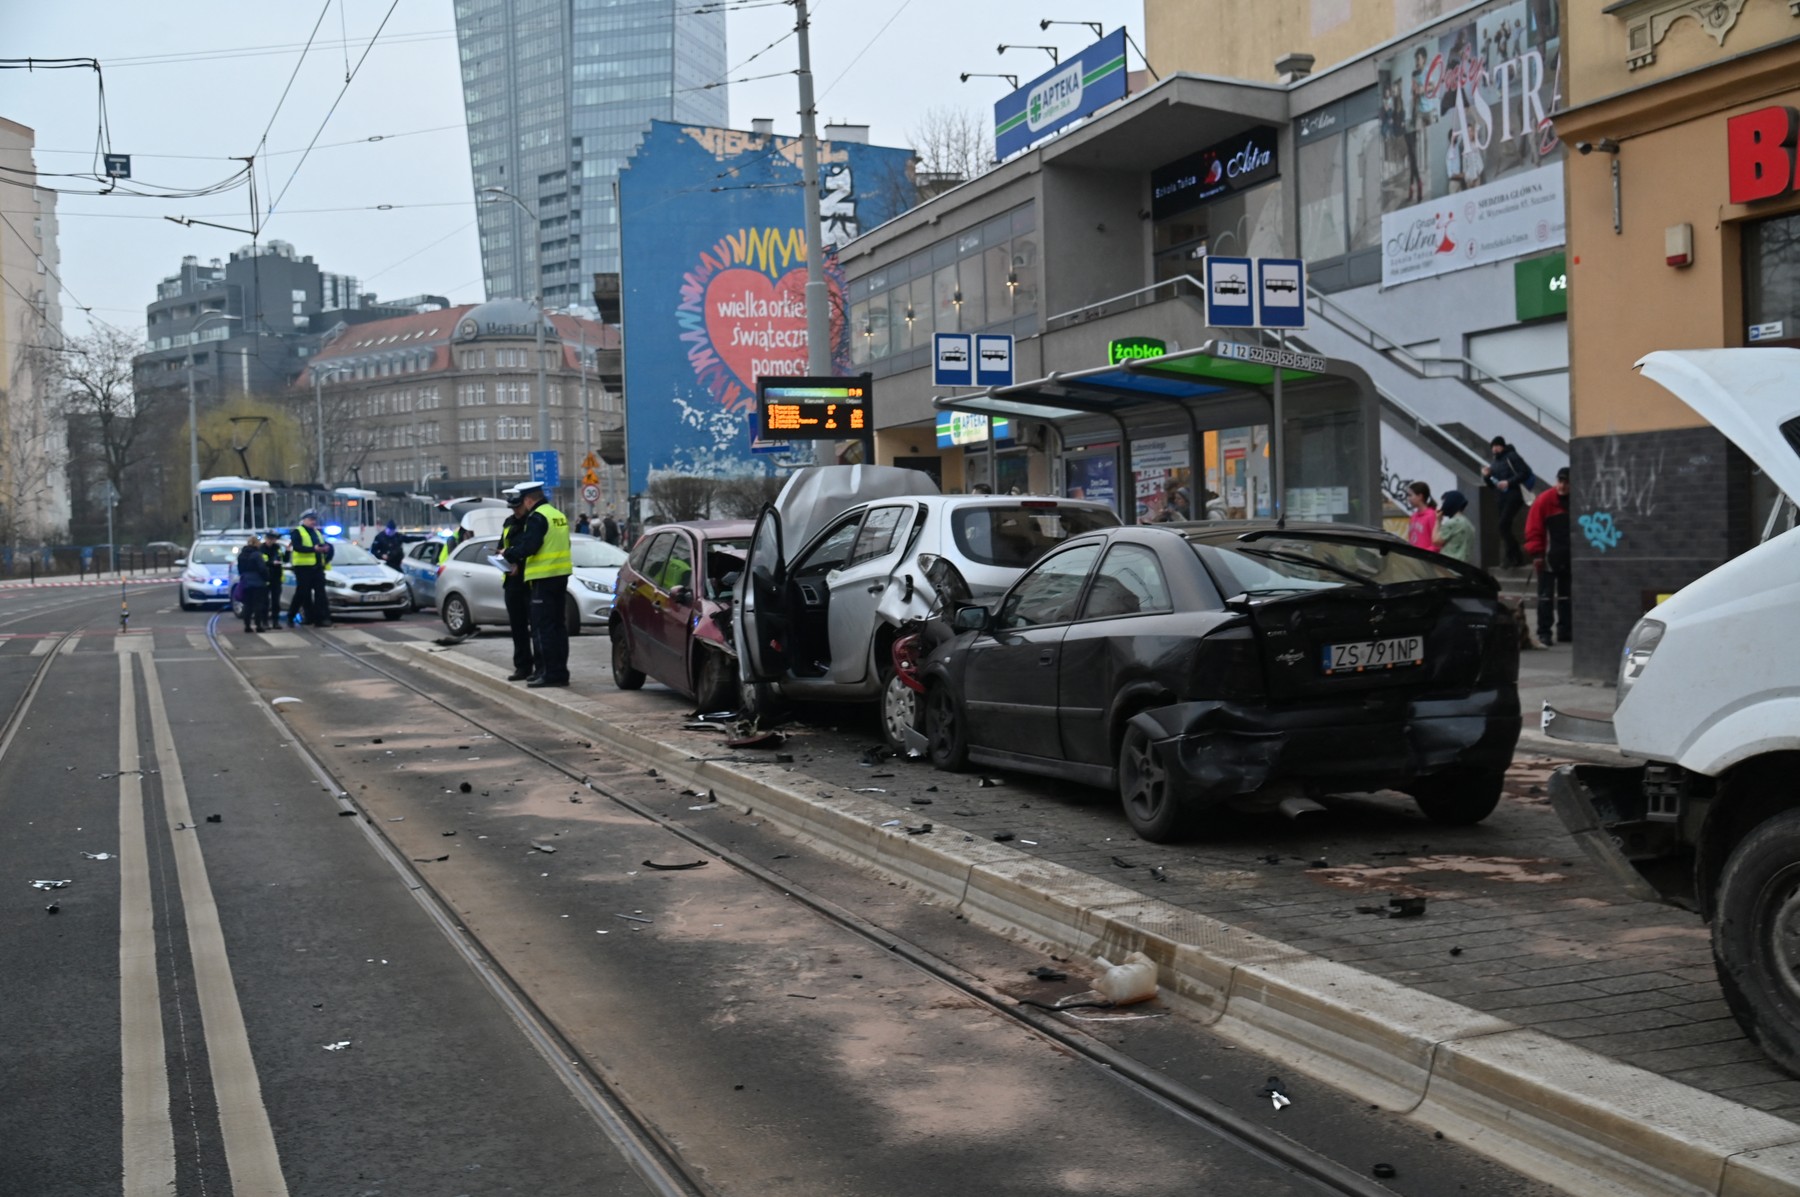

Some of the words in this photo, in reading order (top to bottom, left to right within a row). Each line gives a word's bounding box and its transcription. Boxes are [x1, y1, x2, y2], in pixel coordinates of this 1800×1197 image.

[1042, 72, 1079, 109] APTEKA
[1226, 140, 1270, 178] Astra
[1478, 193, 1510, 208] SIEDZIBA
[1510, 183, 1543, 200] GŁÓWNA
[1387, 222, 1437, 257] Astra
[717, 290, 769, 319] wielka
[1115, 344, 1163, 360] żabka
[1222, 343, 1228, 355] 2
[1237, 346, 1246, 358] 12
[1251, 347, 1263, 361] 522
[1265, 350, 1278, 363] 523
[1281, 352, 1294, 365] 525
[1296, 355, 1309, 369] 530
[1311, 357, 1324, 371] 532
[962, 413, 986, 428] APTEKA
[586, 489, 597, 498] 30
[1334, 646, 1359, 667] ZS
[1365, 639, 1419, 664] 791NP
